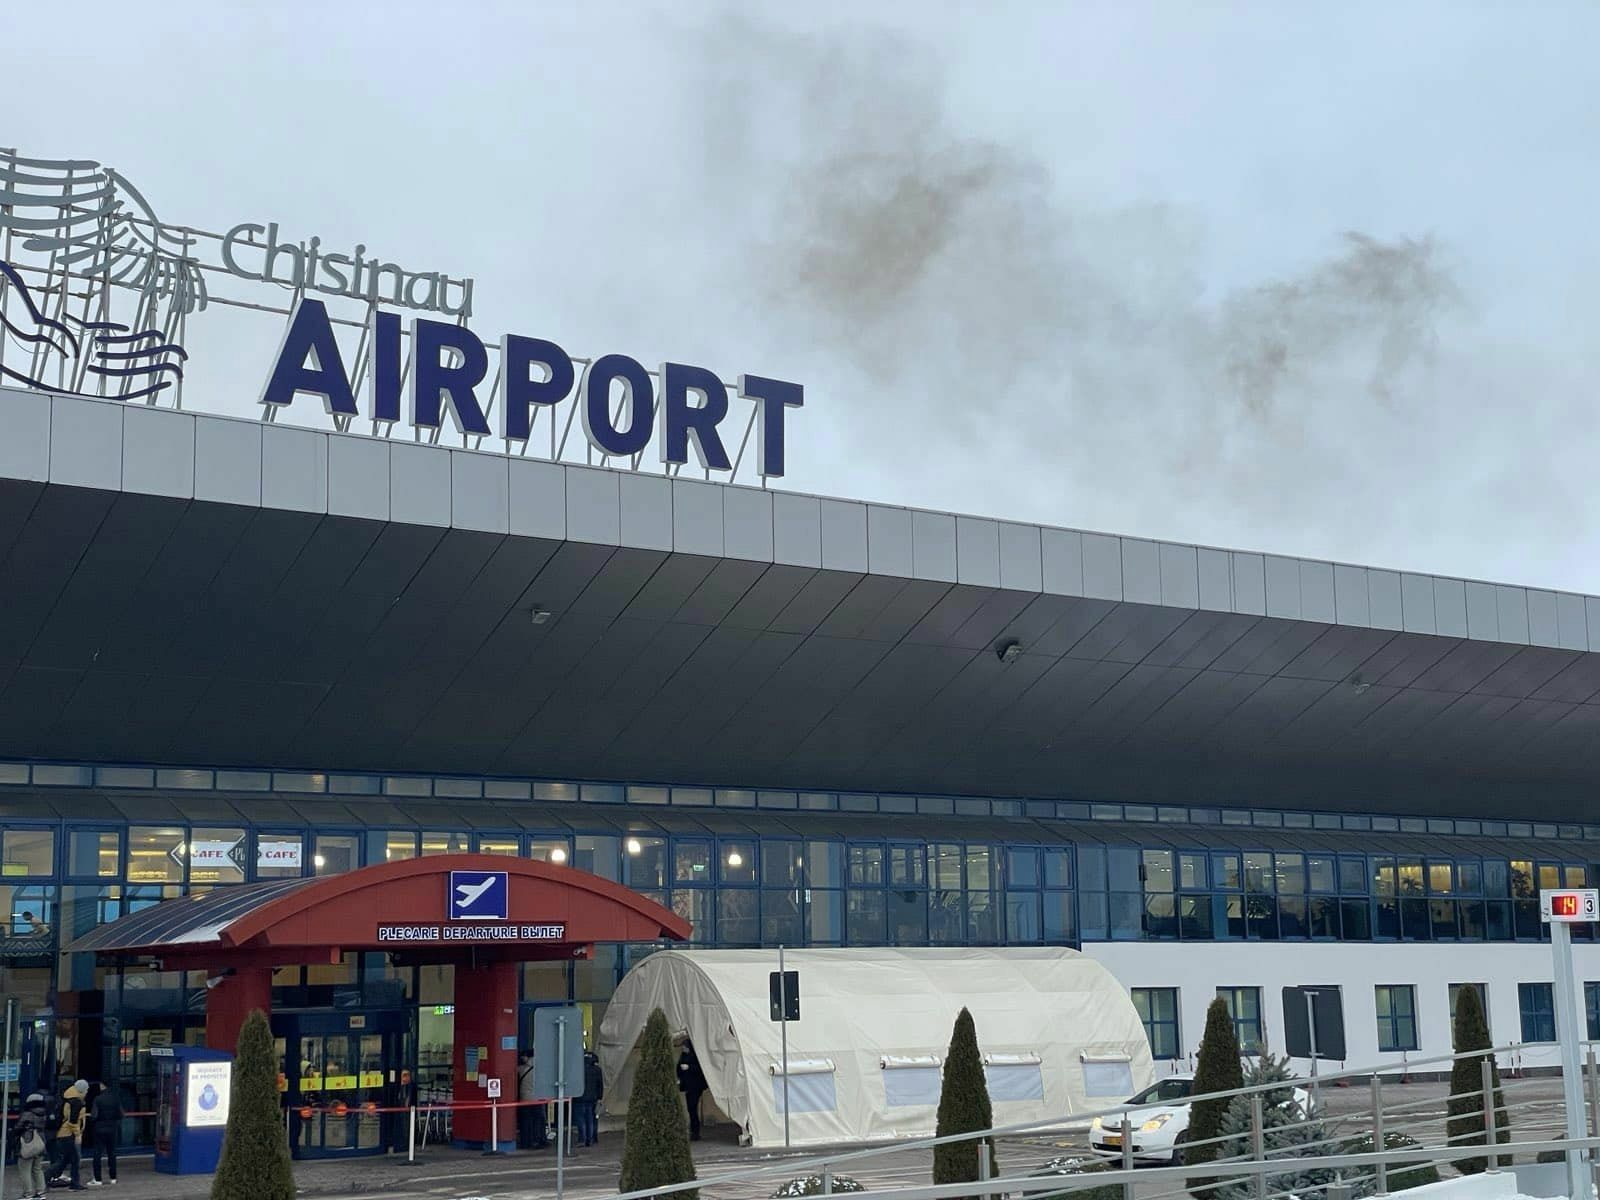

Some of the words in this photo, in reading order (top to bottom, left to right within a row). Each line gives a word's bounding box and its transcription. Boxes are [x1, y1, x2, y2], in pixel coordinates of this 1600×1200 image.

[221, 222, 474, 318] Chisinau
[258, 297, 805, 478] AIRPORT
[265, 850, 297, 859] CAFE
[1563, 896, 1575, 913] 14
[1586, 900, 1594, 912] 3
[378, 927, 440, 941] PLECARE
[443, 926, 518, 940] DEPARTURE
[520, 925, 565, 939] ВЫЛЕТ
